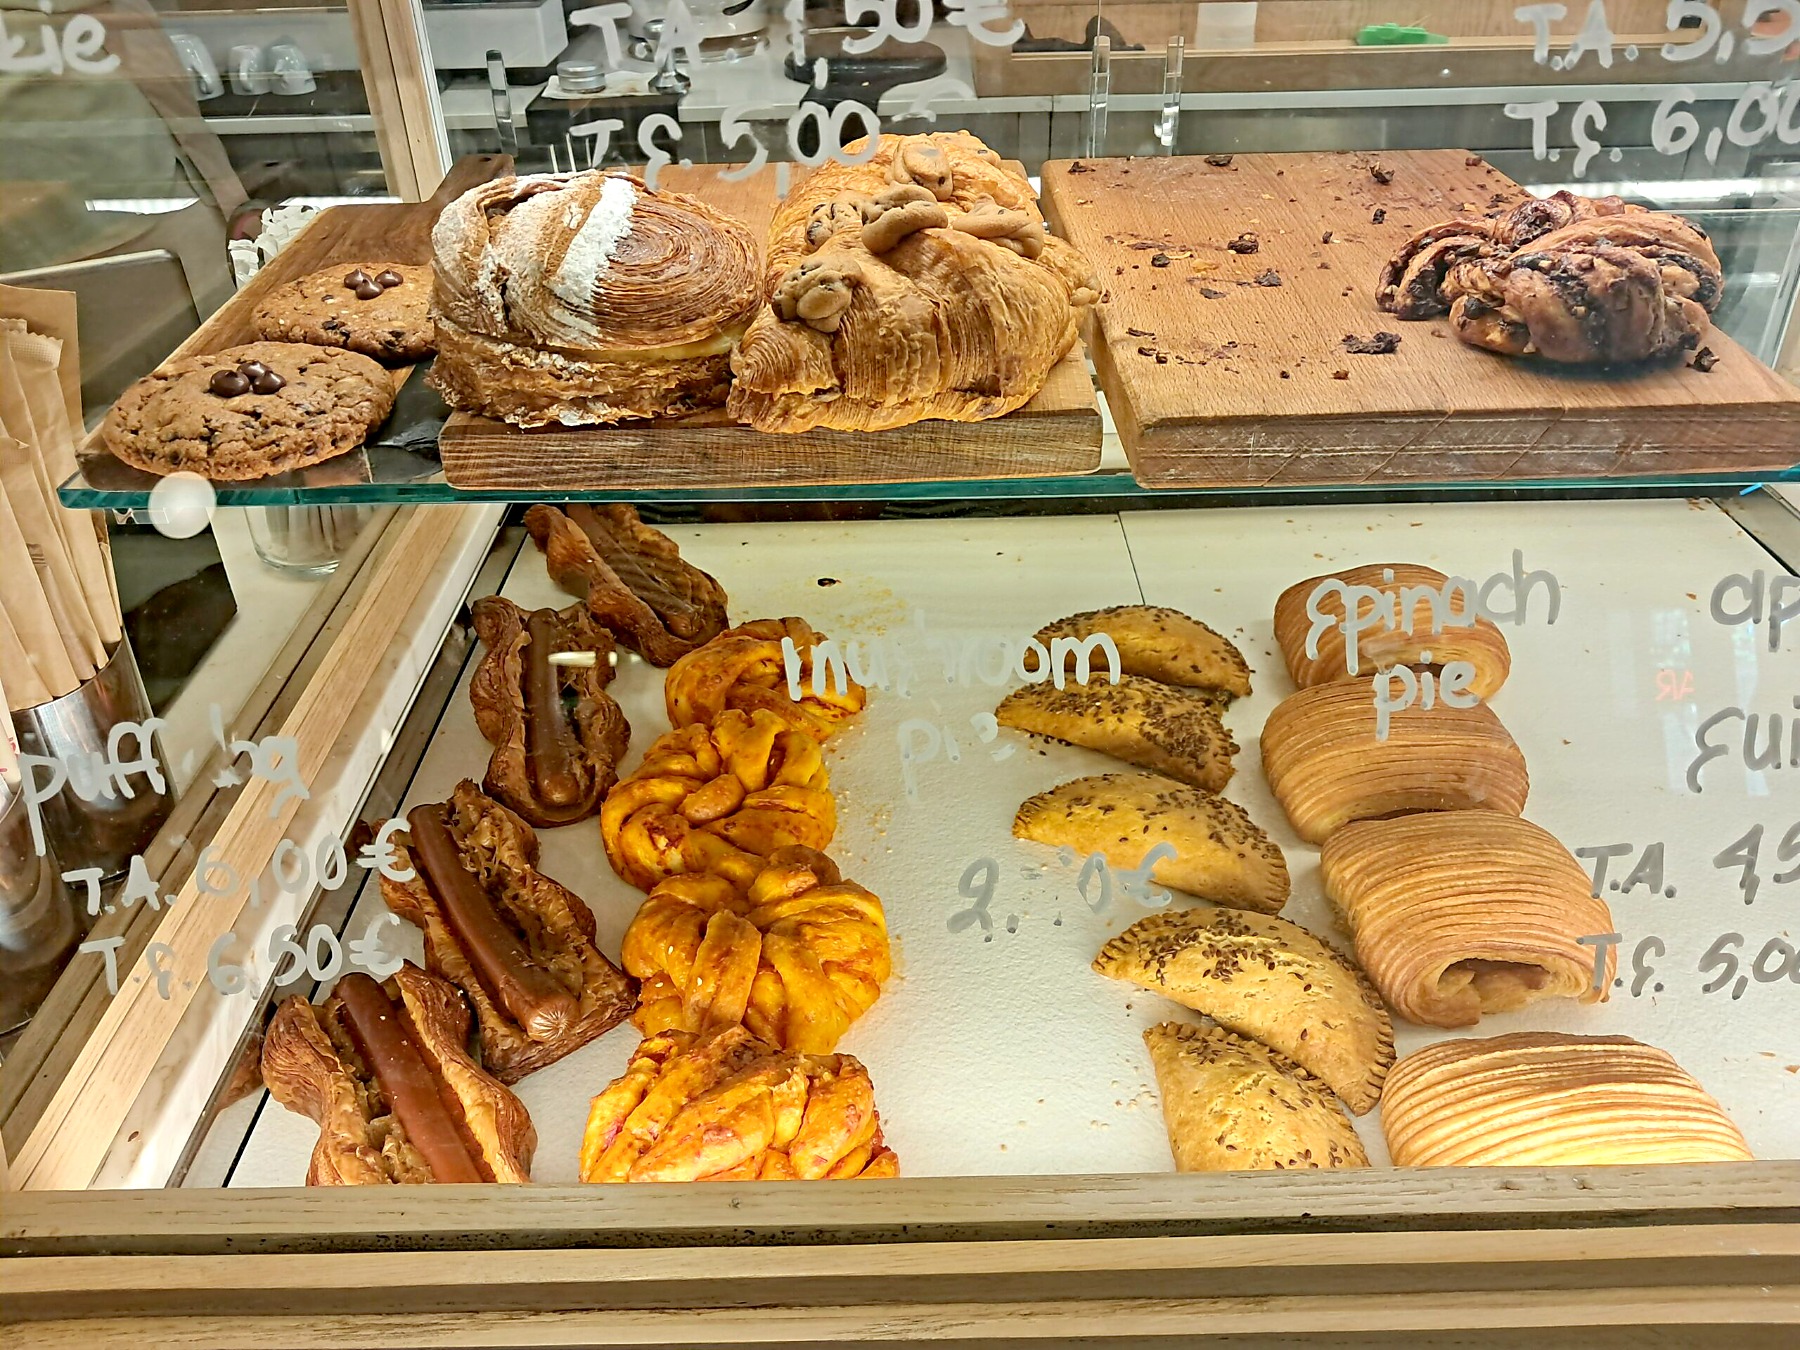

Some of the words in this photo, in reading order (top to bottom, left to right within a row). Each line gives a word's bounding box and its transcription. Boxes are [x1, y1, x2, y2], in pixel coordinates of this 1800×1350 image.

[1514, 0, 1639, 69] T.A.
[1373, 650, 1480, 741] pie
[62, 854, 177, 917] T.A.
[1575, 842, 1679, 899] T.A.
